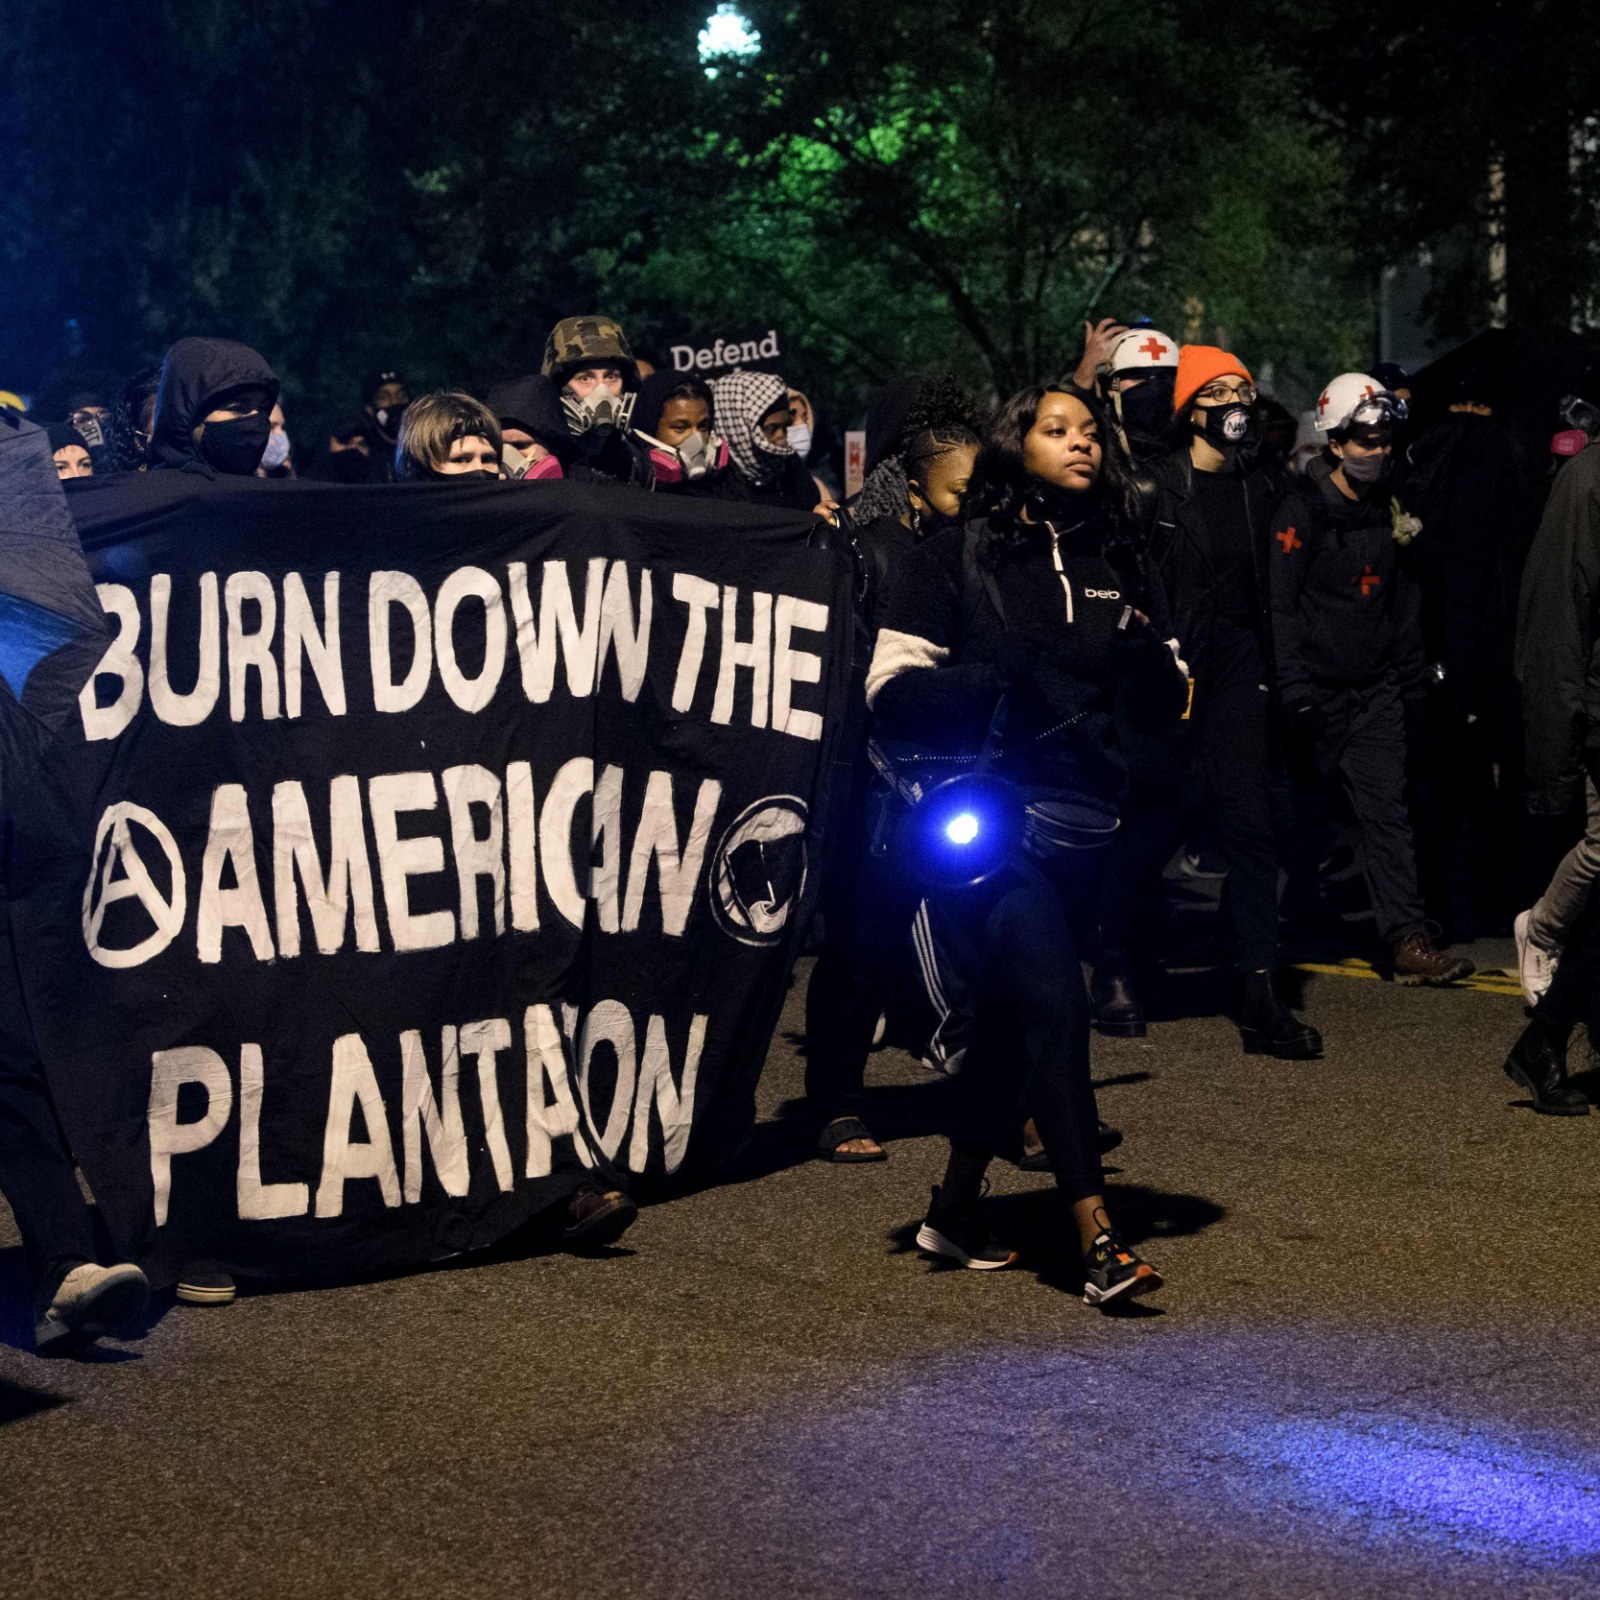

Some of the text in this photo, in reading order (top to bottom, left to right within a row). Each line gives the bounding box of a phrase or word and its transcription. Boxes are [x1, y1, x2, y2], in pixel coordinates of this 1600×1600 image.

[670, 330, 780, 372] Defend
[79, 556, 830, 742] BURN DOWN THE
[197, 756, 723, 964] AMERICAN
[148, 998, 709, 1227] PLANTAON
